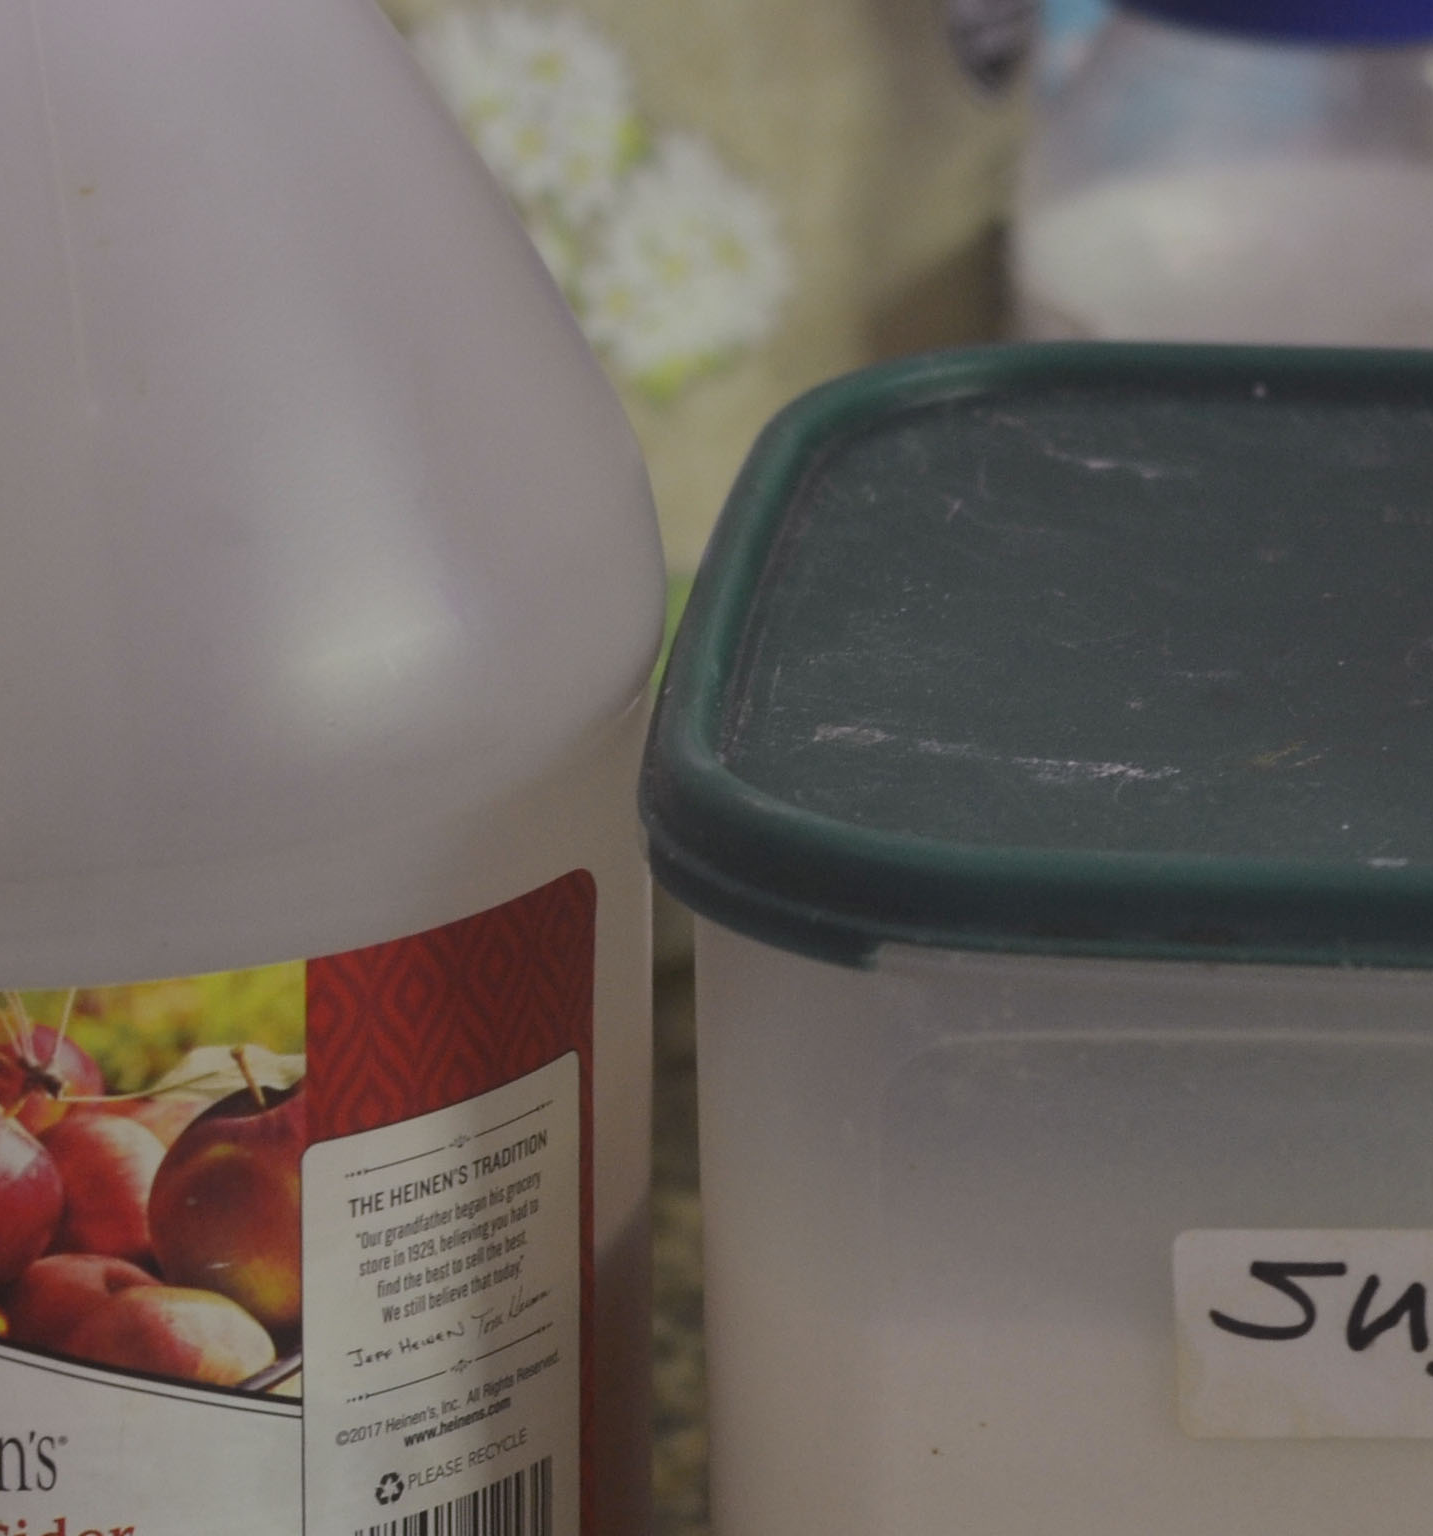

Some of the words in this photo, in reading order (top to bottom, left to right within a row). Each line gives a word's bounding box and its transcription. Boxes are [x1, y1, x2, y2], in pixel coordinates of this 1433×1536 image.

[348, 1192, 384, 1217] THE
[390, 1165, 467, 1208] HEINEN'S
[472, 1129, 548, 1179] TRADITION
[359, 1255, 390, 1276] store
[394, 1250, 405, 1267] in
[439, 1221, 489, 1251] believing
[490, 1215, 508, 1237] you
[510, 1200, 528, 1221] had
[529, 1199, 539, 1214] to
[385, 1208, 452, 1247] grandfather
[455, 1196, 486, 1219] began
[489, 1186, 505, 1204] his
[377, 1276, 401, 1298] find
[403, 1272, 422, 1289] the
[425, 1263, 450, 1283] best
[452, 1258, 462, 1273] to
[465, 1248, 484, 1270] sell
[486, 1241, 503, 1261] the
[505, 1229, 527, 1252] best
[382, 1306, 400, 1323] We
[404, 1294, 426, 1318] still
[428, 1283, 468, 1310] believe
[470, 1271, 492, 1294] that
[467, 1389, 479, 1404] All
[483, 1374, 514, 1397] Rights
[404, 1397, 511, 1447] www.heinens.com
[407, 1457, 463, 1489] PLEASE
[468, 1428, 527, 1467] RECYCLE
